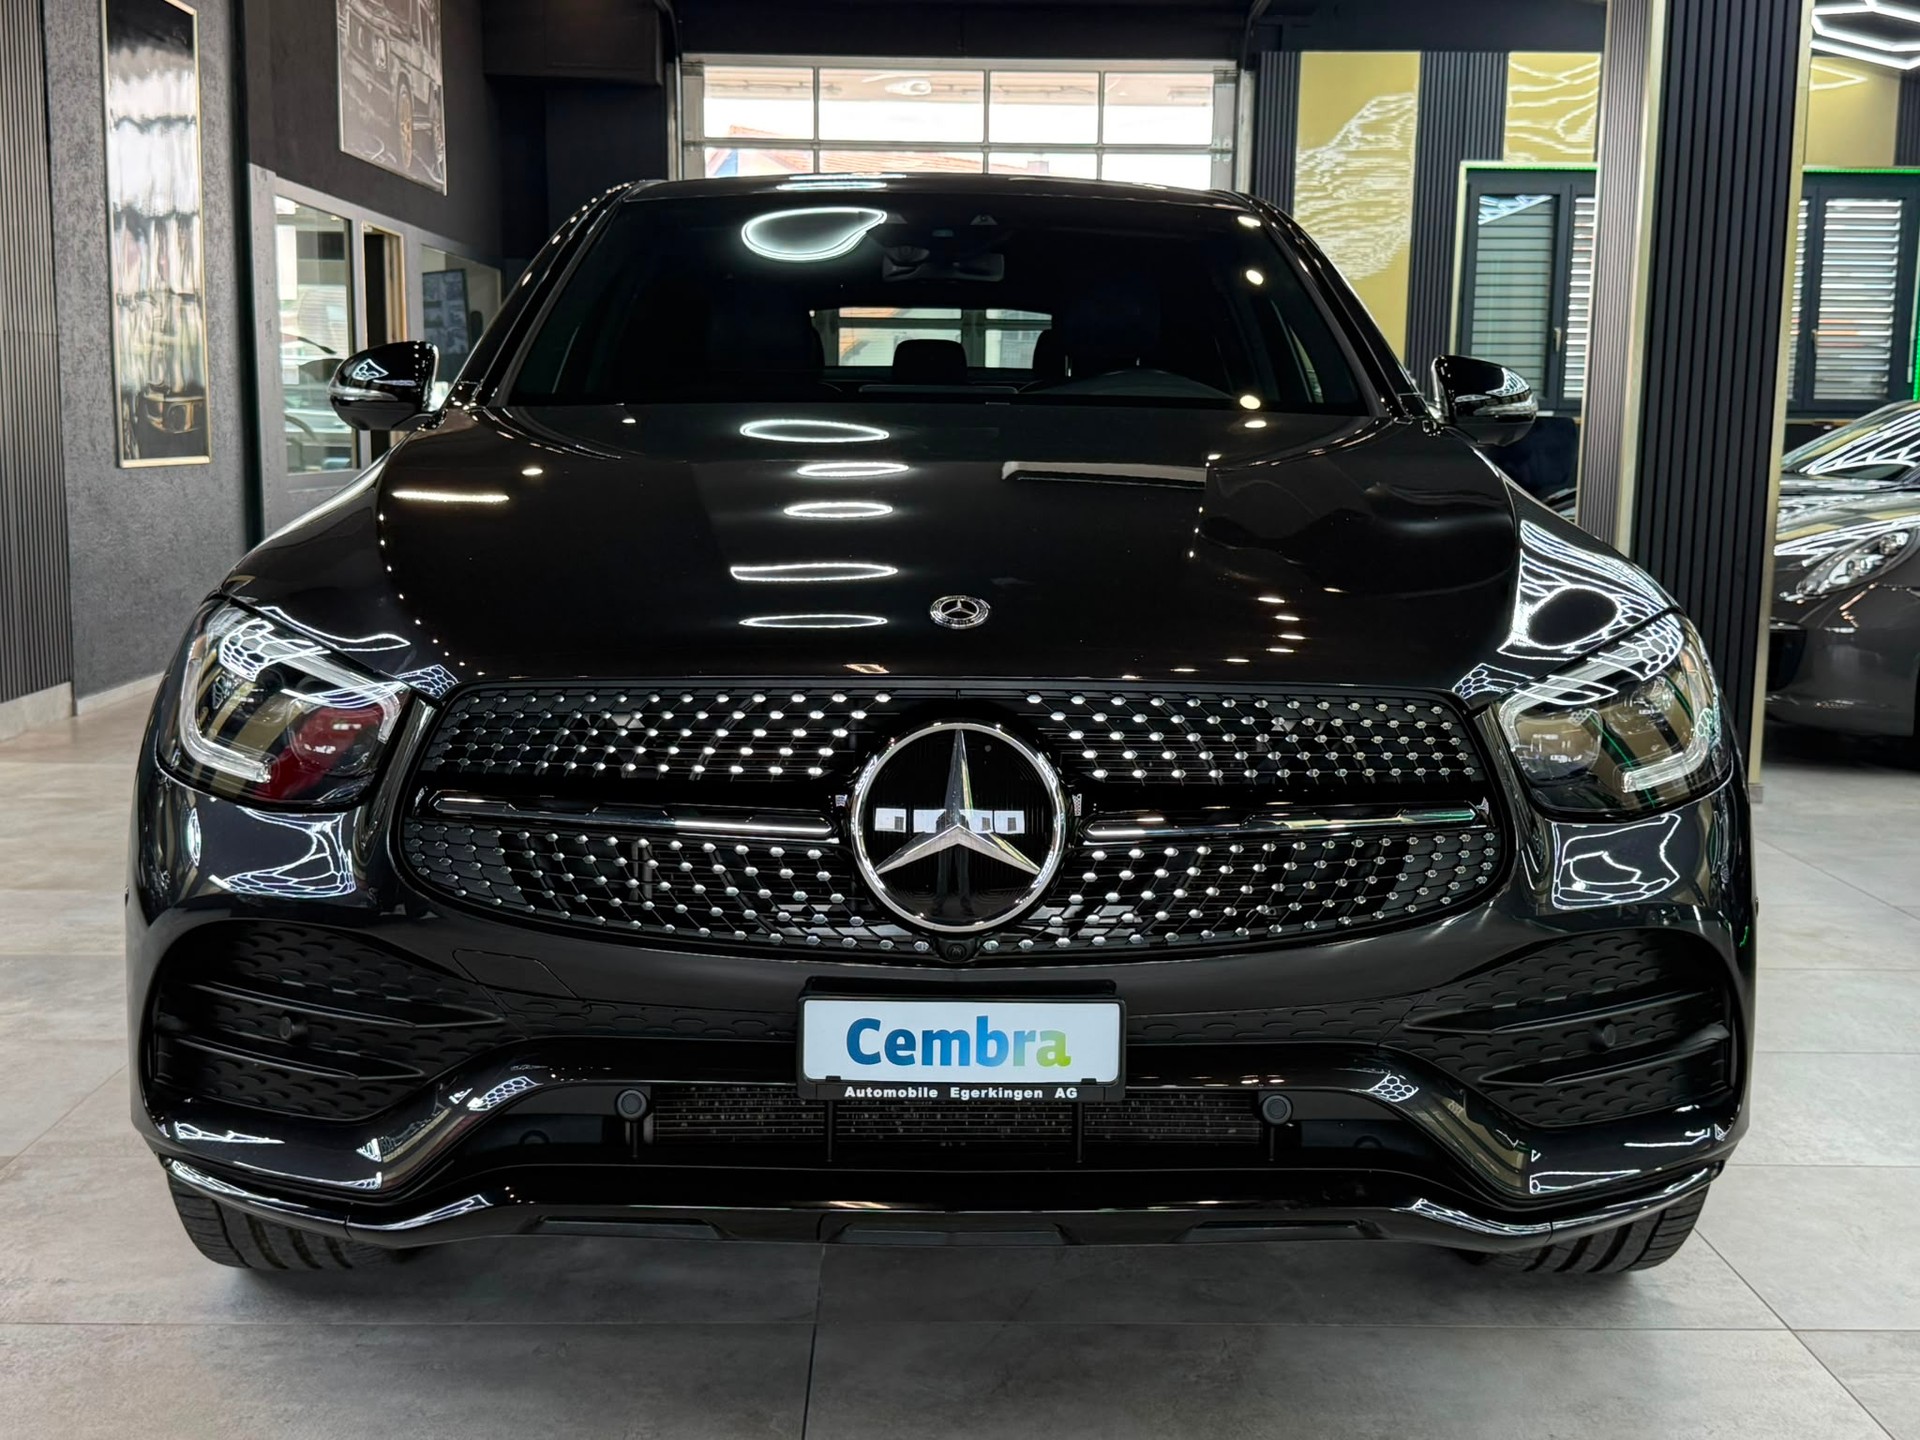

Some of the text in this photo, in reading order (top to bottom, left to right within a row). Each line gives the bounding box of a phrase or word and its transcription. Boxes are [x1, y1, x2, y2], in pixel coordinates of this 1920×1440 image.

[846, 1015, 1071, 1067] Cembra
[844, 1086, 1078, 1101] Automobile Egerkingen AG
